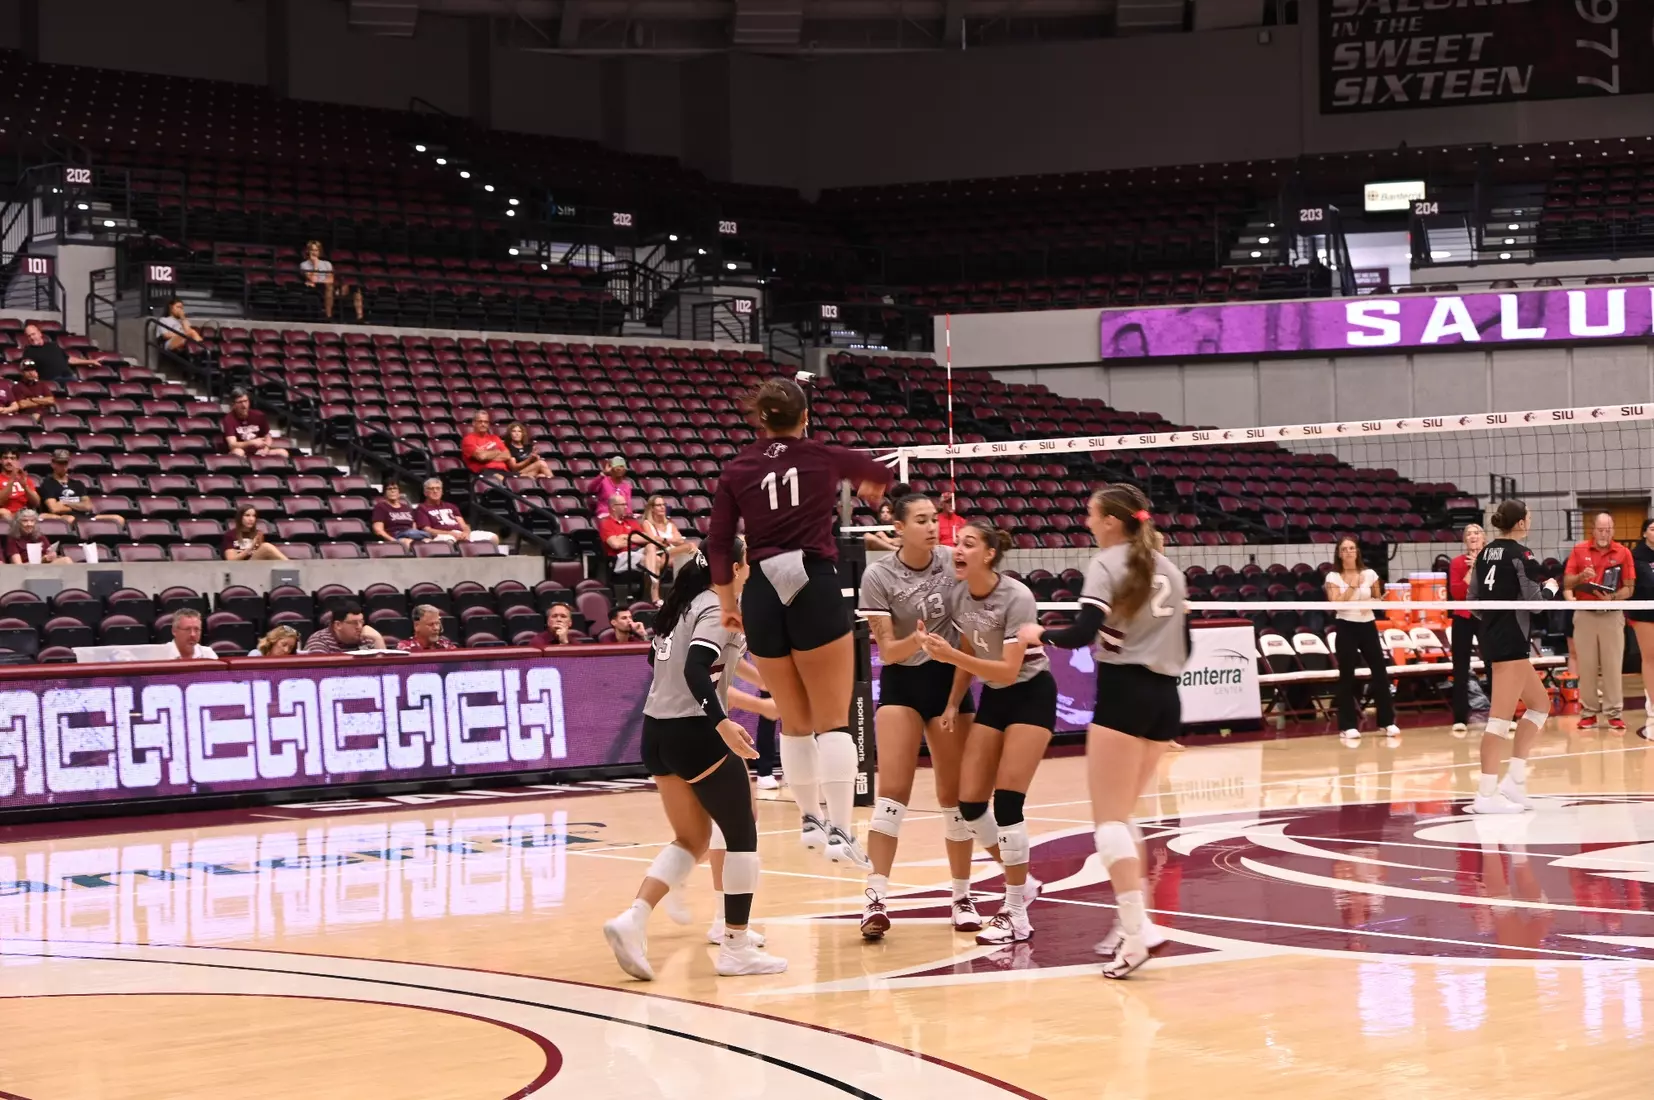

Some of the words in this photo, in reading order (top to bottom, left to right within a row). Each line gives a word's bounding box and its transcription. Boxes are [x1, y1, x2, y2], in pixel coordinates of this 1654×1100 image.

[1331, 22, 1360, 38] IN
[1374, 17, 1424, 34] THE
[1331, 33, 1493, 71] SWEET
[1331, 65, 1534, 106] SIXTEEN
[66, 168, 91, 184] 202
[613, 212, 632, 226] 202
[1298, 208, 1323, 222] 203
[1415, 202, 1439, 216] 204
[718, 221, 738, 234] 203
[28, 258, 48, 275] 101
[150, 265, 173, 282] 102
[735, 299, 752, 314] 102
[821, 304, 838, 318] 103
[1345, 288, 1654, 346] SALU
[945, 446, 960, 455] SIU
[992, 443, 1007, 453] SIU
[1039, 440, 1055, 450] SIU
[1089, 437, 1105, 447] SIU
[1140, 434, 1157, 445] SIU
[1192, 430, 1210, 441] SIU
[1247, 427, 1265, 438] SIU
[1303, 423, 1323, 435] SIU
[1362, 420, 1382, 432] SIU
[1423, 416, 1443, 428] SIU
[1487, 412, 1508, 425] SIU
[1552, 408, 1574, 421] SIU
[1620, 403, 1644, 417] SIU
[760, 466, 800, 511] 11
[1484, 564, 1496, 591] 4
[916, 591, 946, 621] 13
[1151, 573, 1175, 618] 2
[972, 629, 989, 653] 4
[856, 696, 866, 726] sports
[857, 726, 867, 763] imports
